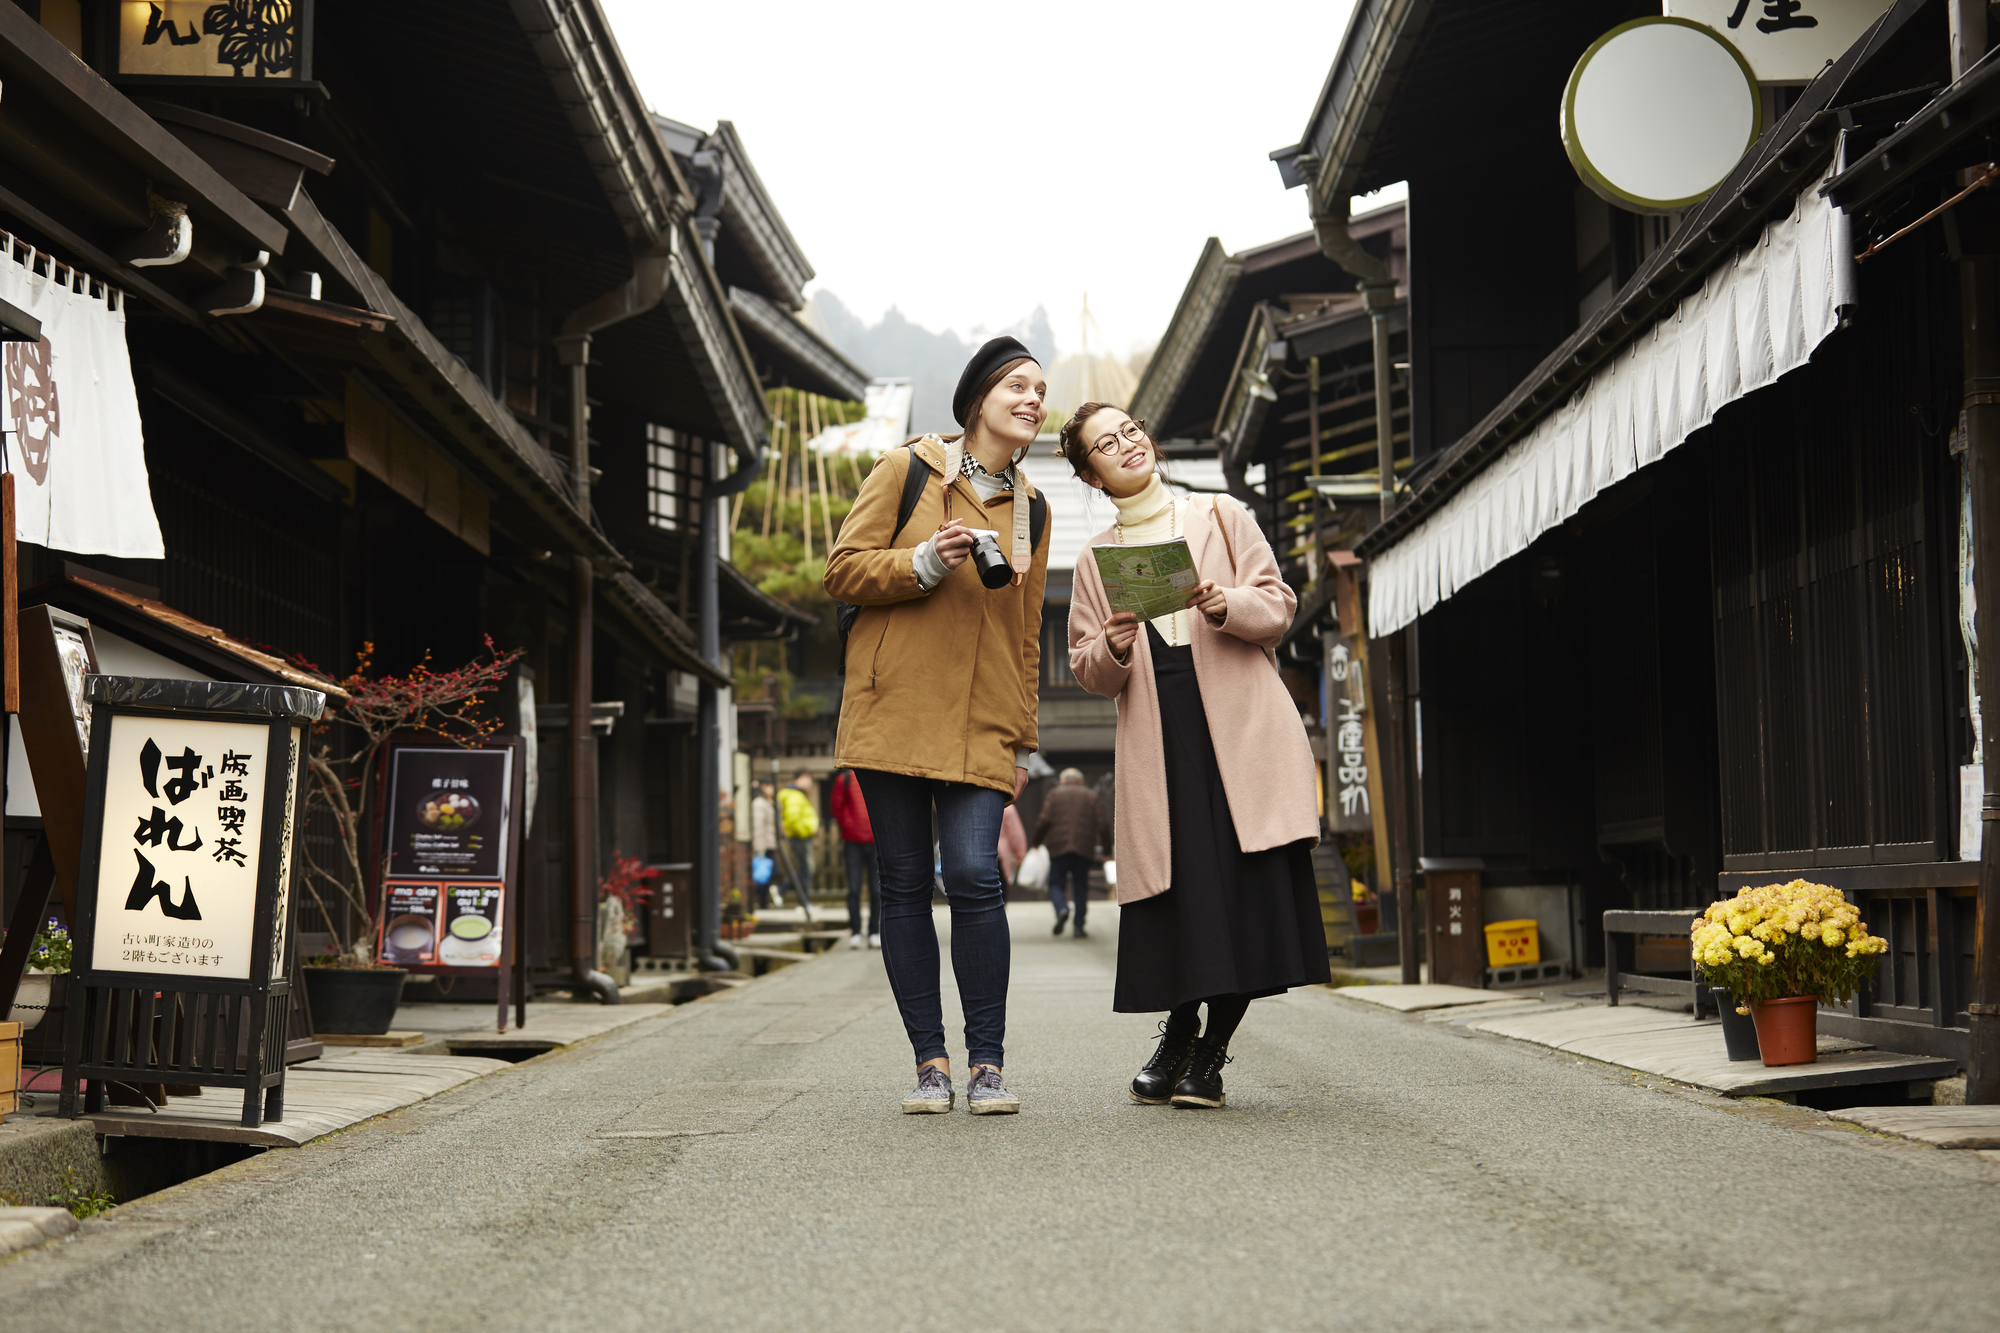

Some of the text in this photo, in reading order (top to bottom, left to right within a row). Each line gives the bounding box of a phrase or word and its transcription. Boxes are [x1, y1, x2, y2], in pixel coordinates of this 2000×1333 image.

[211, 749, 253, 868] 版画喫茶
[124, 737, 215, 921] ばれん
[448, 887, 500, 898] Green Tea
[1449, 887, 1462, 936] 消火器
[122, 932, 214, 949] 古い町家造りの
[122, 949, 224, 967] 2階もございます
